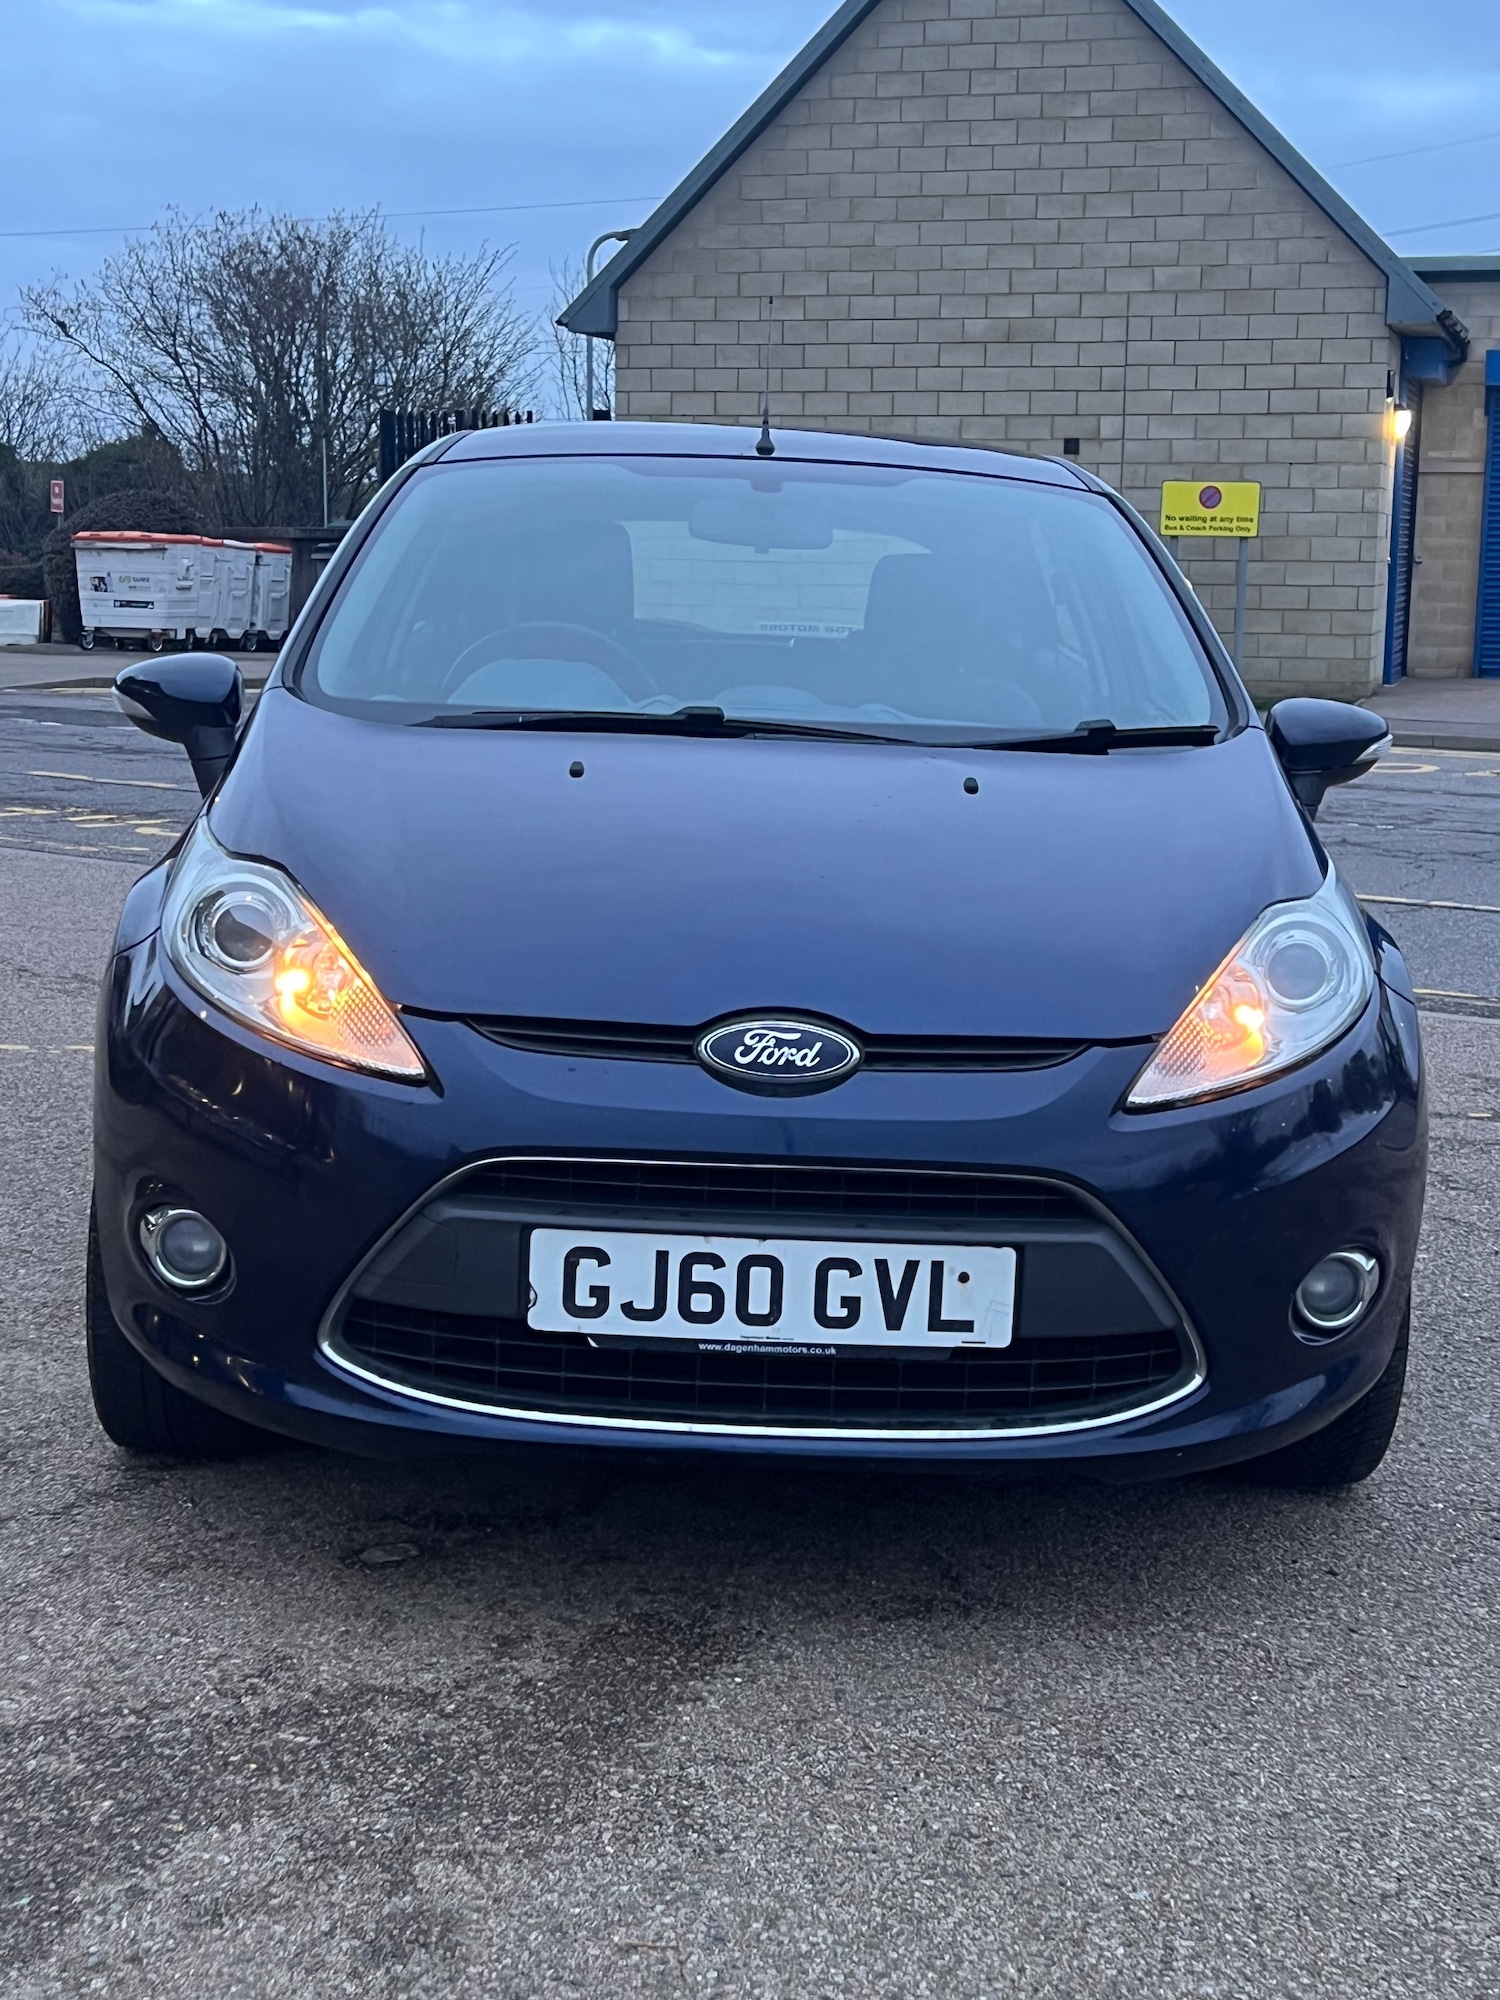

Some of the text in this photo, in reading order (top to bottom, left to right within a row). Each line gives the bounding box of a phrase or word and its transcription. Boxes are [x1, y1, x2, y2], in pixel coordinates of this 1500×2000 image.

[1179, 515, 1207, 524] waiting
[1219, 516, 1234, 524] any
[1235, 525, 1251, 533] Only
[734, 1029, 823, 1067] Ford
[562, 1246, 975, 1333] GJ60 GVL
[698, 1343, 837, 1355] www.dagenhammotors.co.uk
